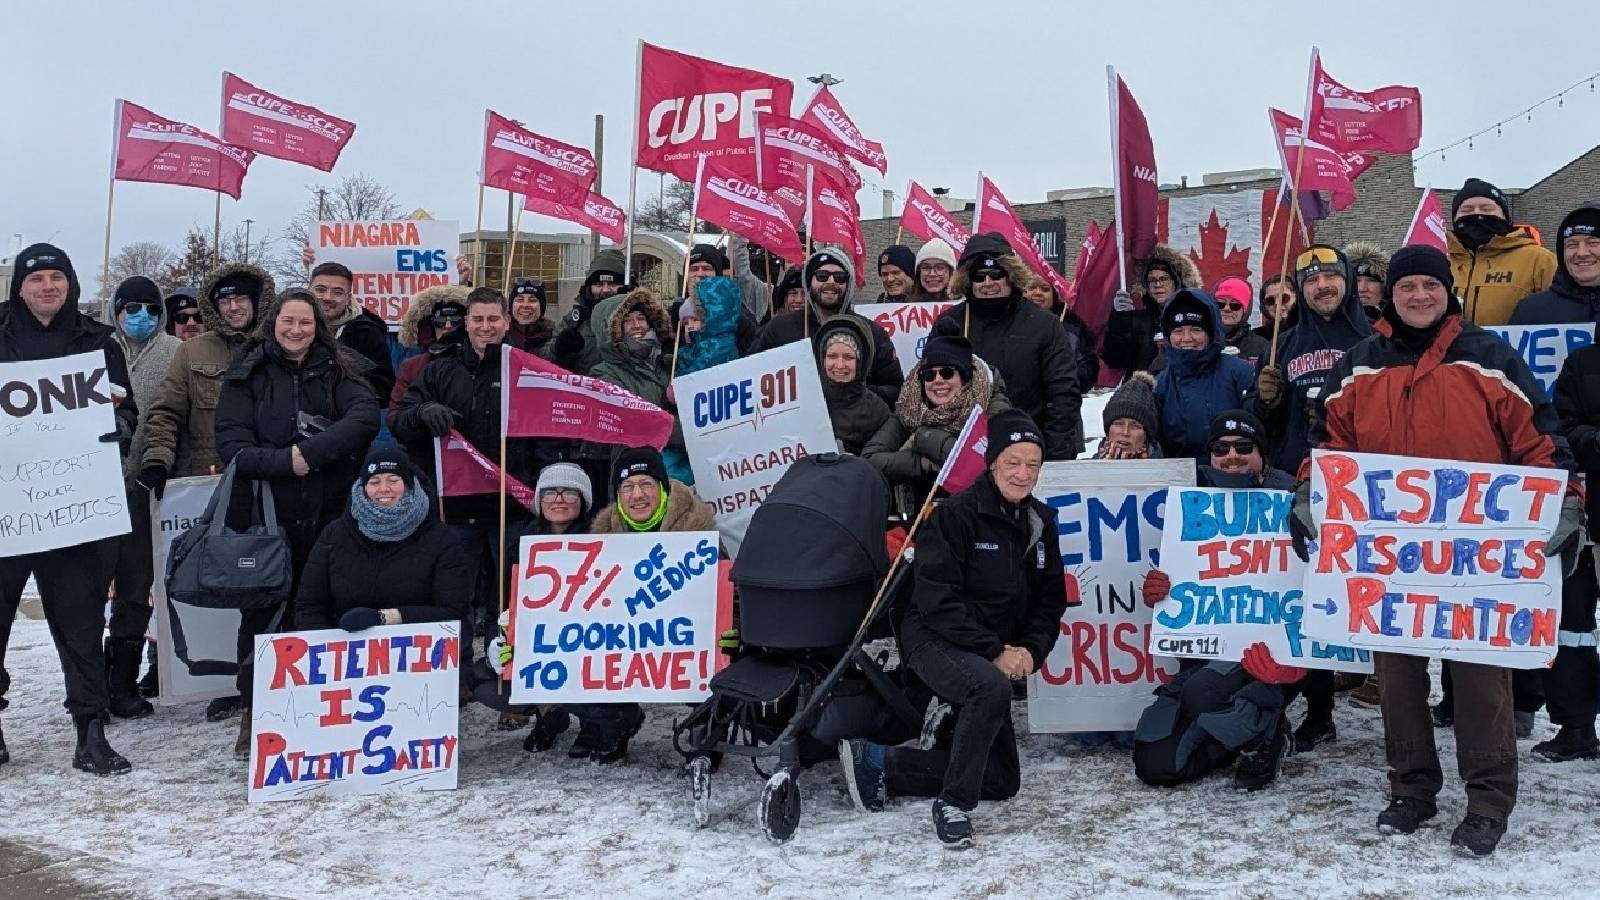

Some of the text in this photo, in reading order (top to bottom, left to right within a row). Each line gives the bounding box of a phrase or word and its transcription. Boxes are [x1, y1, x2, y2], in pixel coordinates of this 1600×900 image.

[776, 127, 822, 150] CUPE
[726, 178, 768, 203] CUPE
[320, 222, 421, 248] NIAGARA
[397, 249, 448, 272] EMS
[1485, 271, 1513, 284] HH
[0, 368, 113, 418] ONK
[694, 379, 754, 428] CUPE
[760, 365, 797, 409] 911
[718, 443, 808, 482] NIAGARA
[1316, 454, 1562, 524] RESPECT
[1044, 489, 1168, 568] EMS
[1315, 523, 1548, 580] RESOURCES
[522, 540, 668, 612] 57% OF
[624, 538, 718, 617] MEDICS
[1095, 580, 1136, 614] IN
[1156, 582, 1304, 629] STAFFING
[1346, 577, 1557, 648] RETENTION
[533, 617, 694, 654] LOOKING
[1157, 636, 1219, 655] CUPE 911
[269, 635, 459, 690] RETENTION
[519, 650, 709, 692] TO LEAVE!
[320, 685, 391, 728] IS
[253, 725, 458, 790] PATIENT SAFETY
